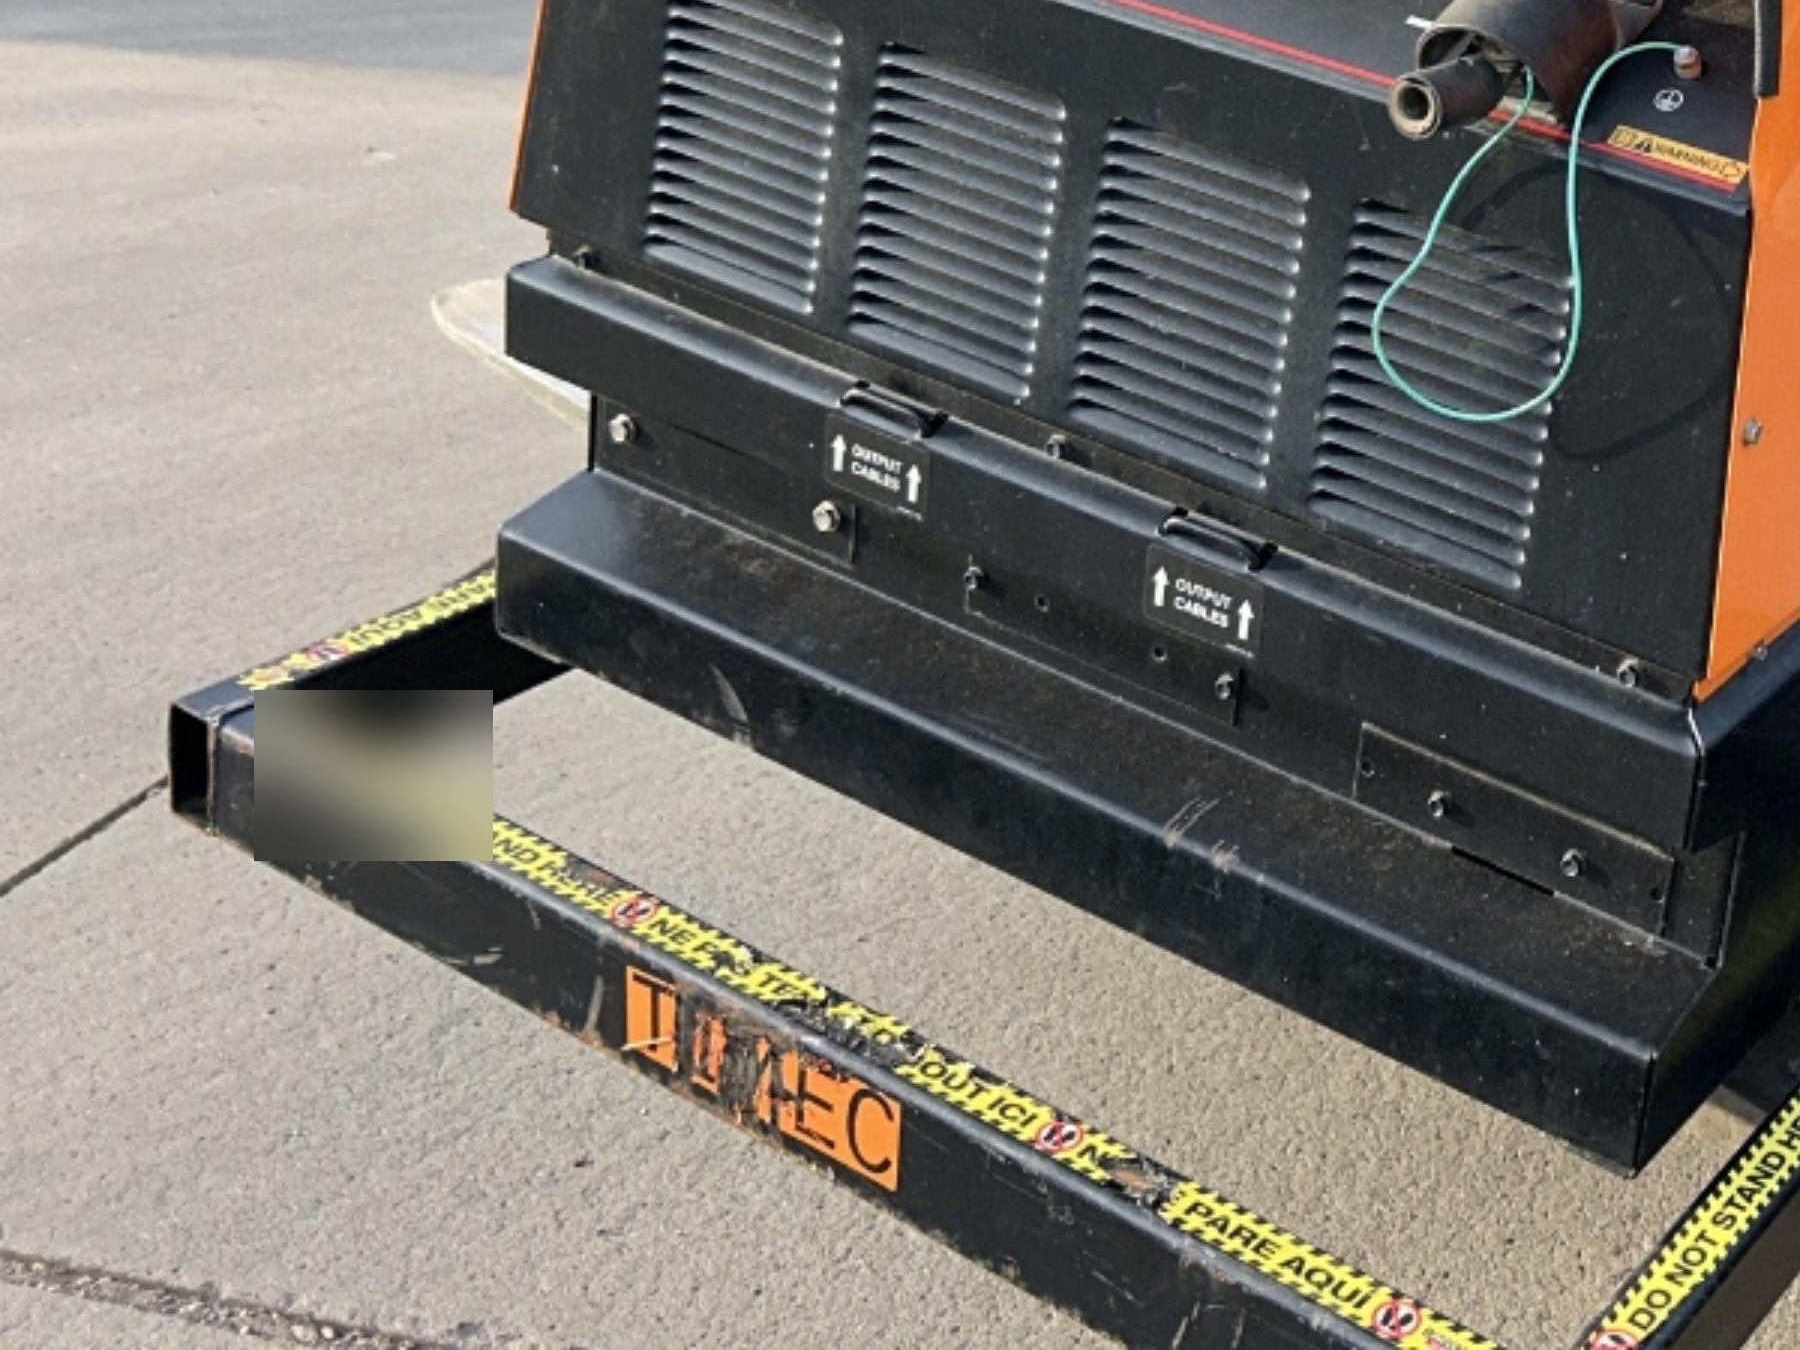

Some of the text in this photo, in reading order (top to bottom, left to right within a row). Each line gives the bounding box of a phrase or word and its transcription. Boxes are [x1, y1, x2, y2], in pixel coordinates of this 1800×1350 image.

[851, 442, 903, 475] OUTPUT
[850, 460, 902, 493] CABLES
[1174, 576, 1232, 611] OUTPUT
[1173, 597, 1230, 630] CABLES
[653, 918, 692, 949] NE
[989, 1096, 1036, 1128] ICI
[1185, 1201, 1282, 1260] PARE
[1629, 1287, 1673, 1333] DO
[1669, 1235, 1715, 1285] NOT
[1713, 1146, 1787, 1232] STAND
